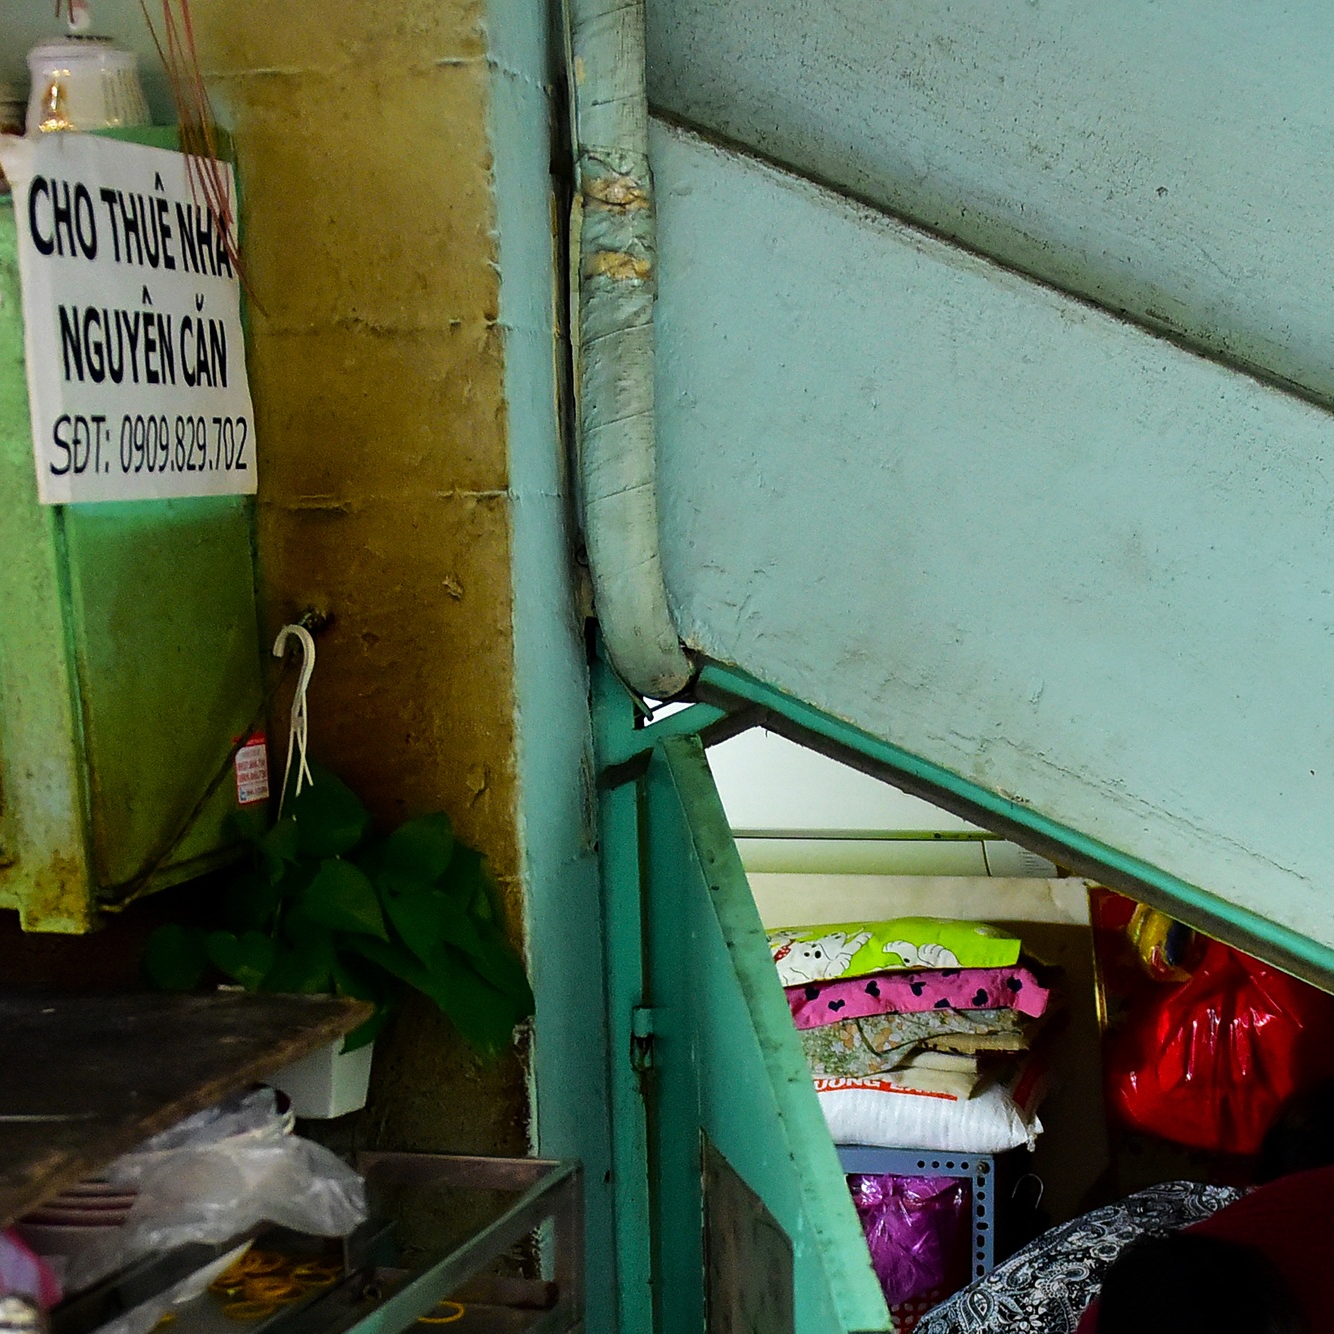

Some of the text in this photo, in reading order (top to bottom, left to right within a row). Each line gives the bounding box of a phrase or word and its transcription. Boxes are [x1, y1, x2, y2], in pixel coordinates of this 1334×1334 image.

[28, 175, 99, 263] CHO
[100, 180, 177, 272] THUÊ
[58, 285, 229, 389] NGUYÊN CĂN
[50, 413, 249, 477] SĐT: 0909.829.702
